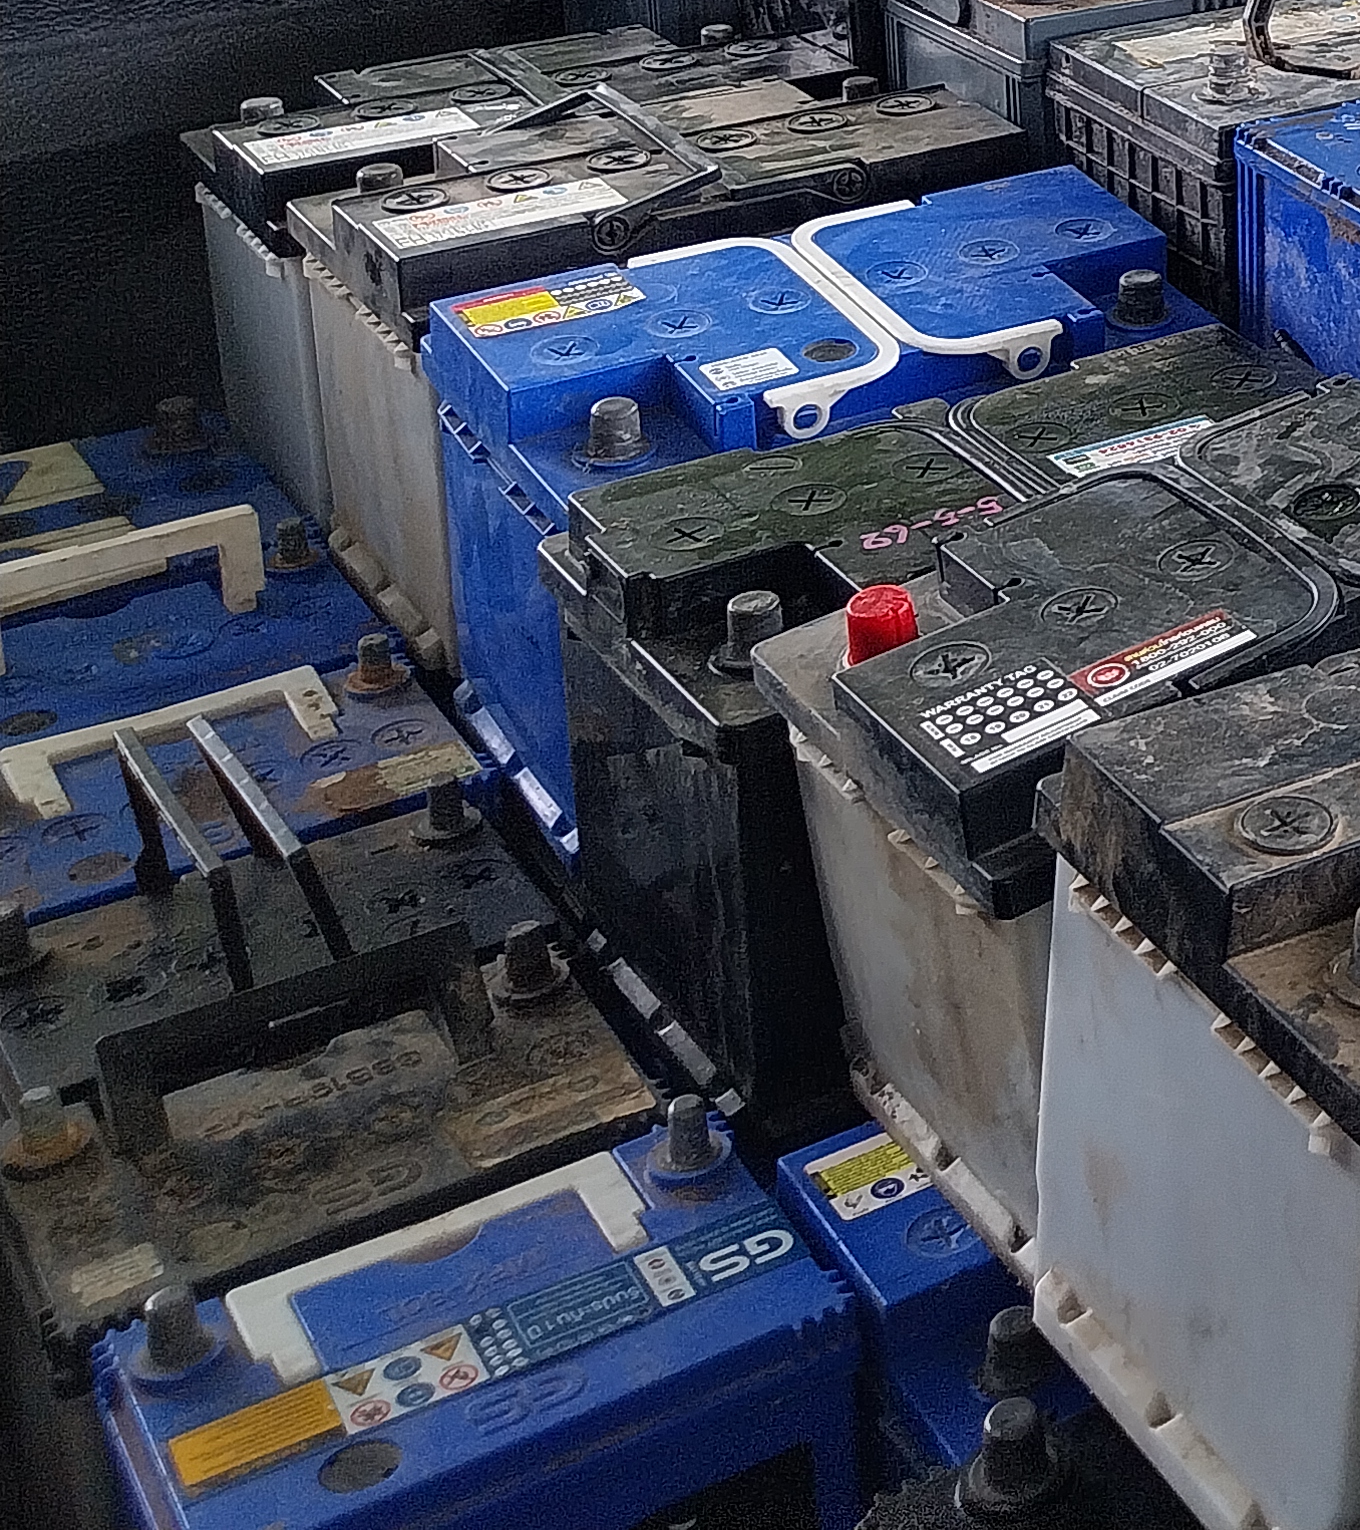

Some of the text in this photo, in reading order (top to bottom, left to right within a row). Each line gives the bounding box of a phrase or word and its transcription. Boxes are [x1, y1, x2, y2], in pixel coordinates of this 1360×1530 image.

[859, 495, 1004, 551] 5-5-62
[919, 664, 1038, 720] WARRANTY TAG
[698, 1228, 796, 1283] GS
[553, 1283, 642, 1327] รับประกัน
